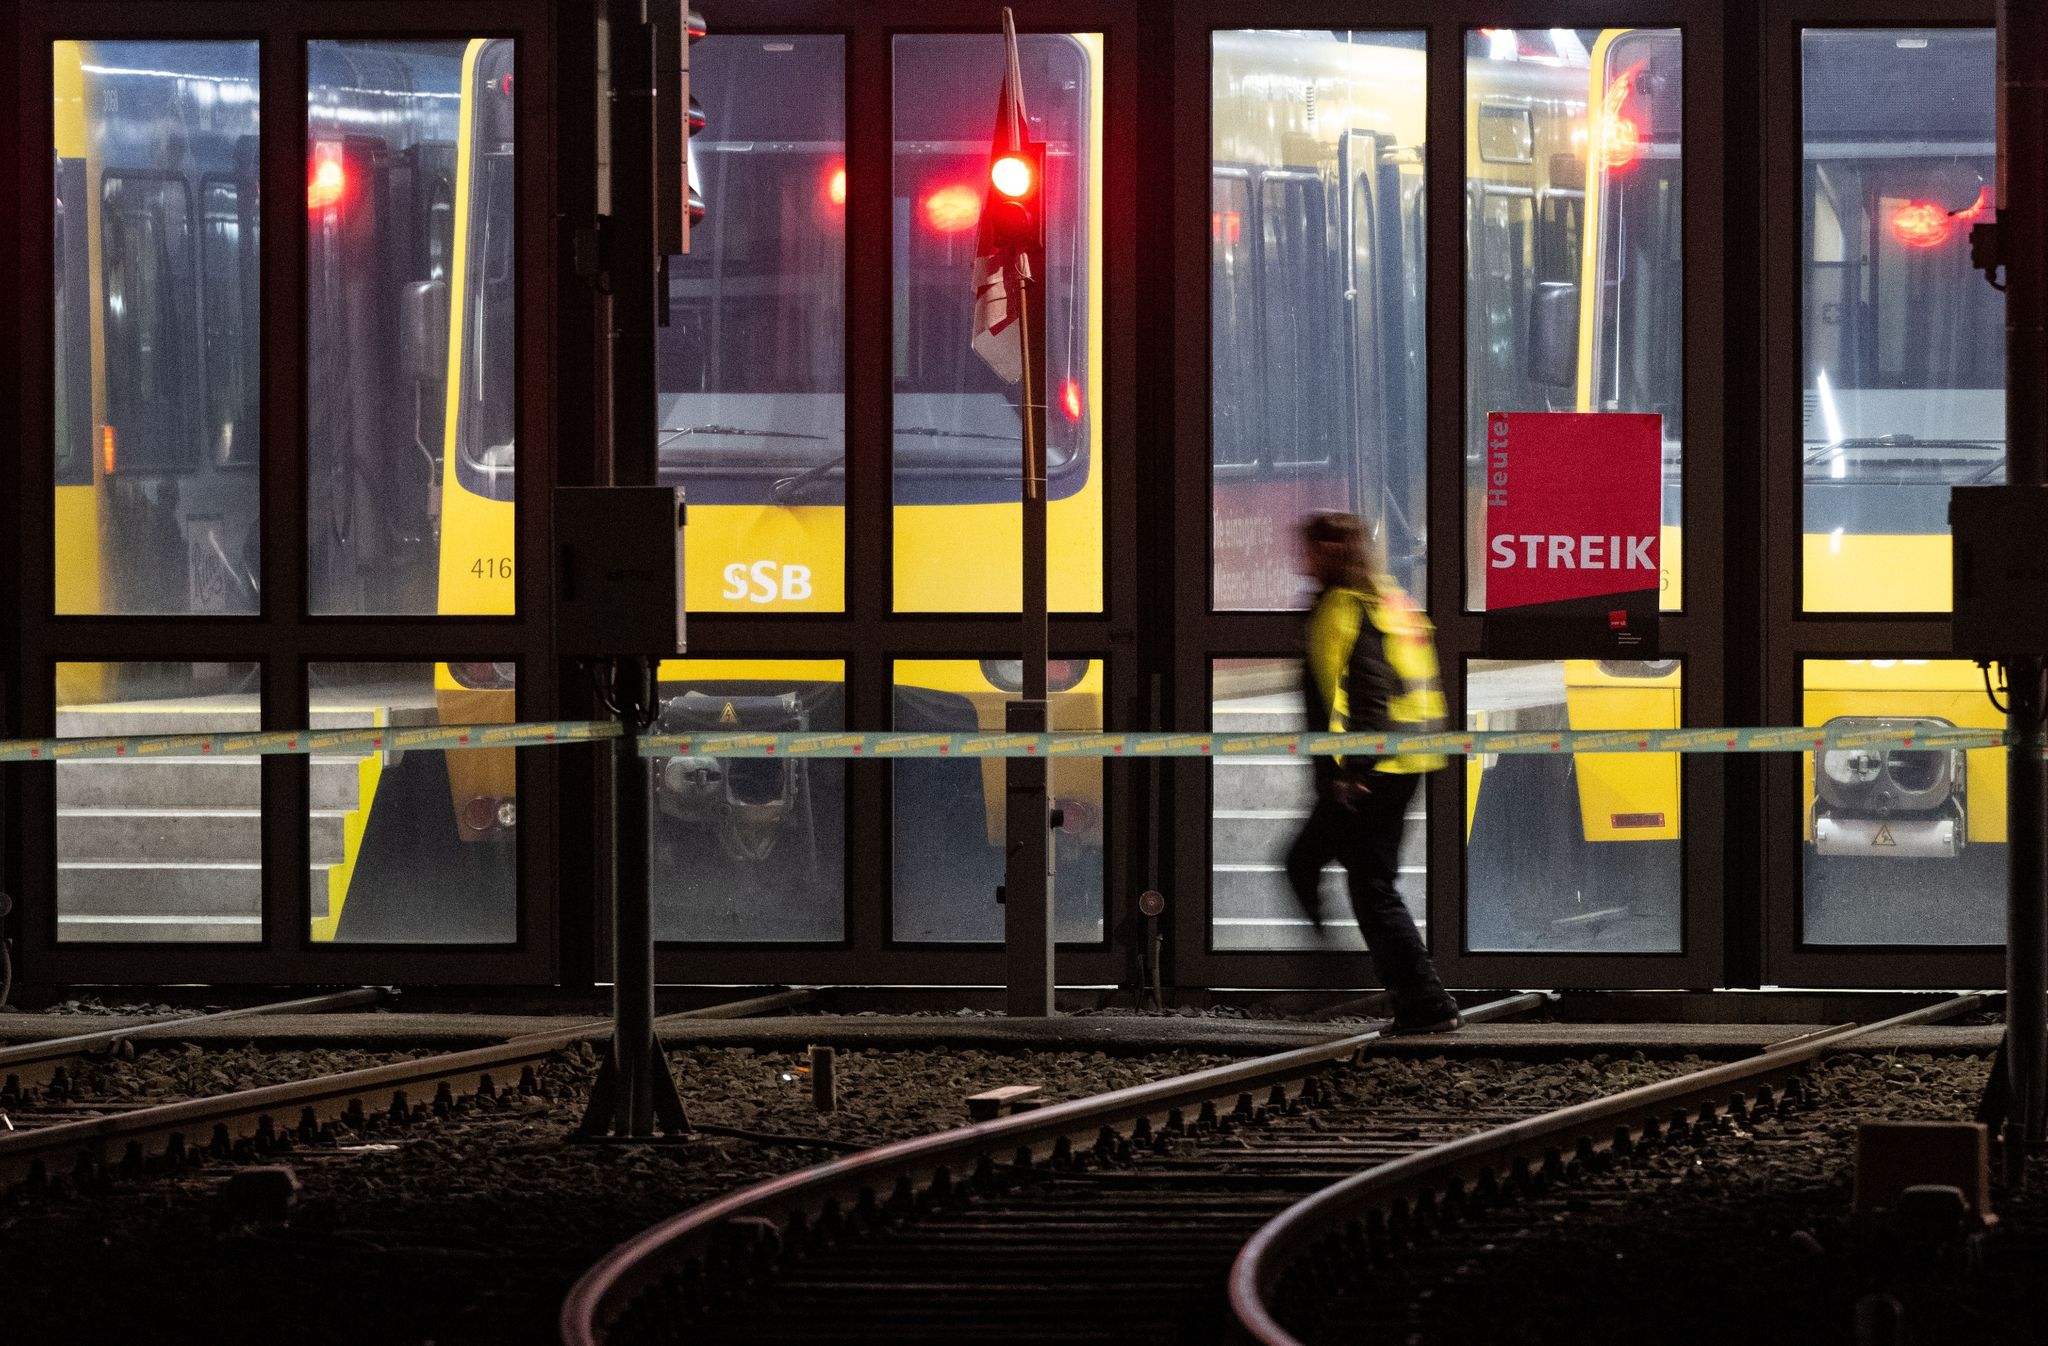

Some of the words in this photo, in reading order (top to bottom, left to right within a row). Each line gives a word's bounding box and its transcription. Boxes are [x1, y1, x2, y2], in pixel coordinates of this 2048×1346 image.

[471, 557, 512, 579] 416
[1490, 534, 1657, 569] STREIK
[723, 560, 812, 603] SSB
